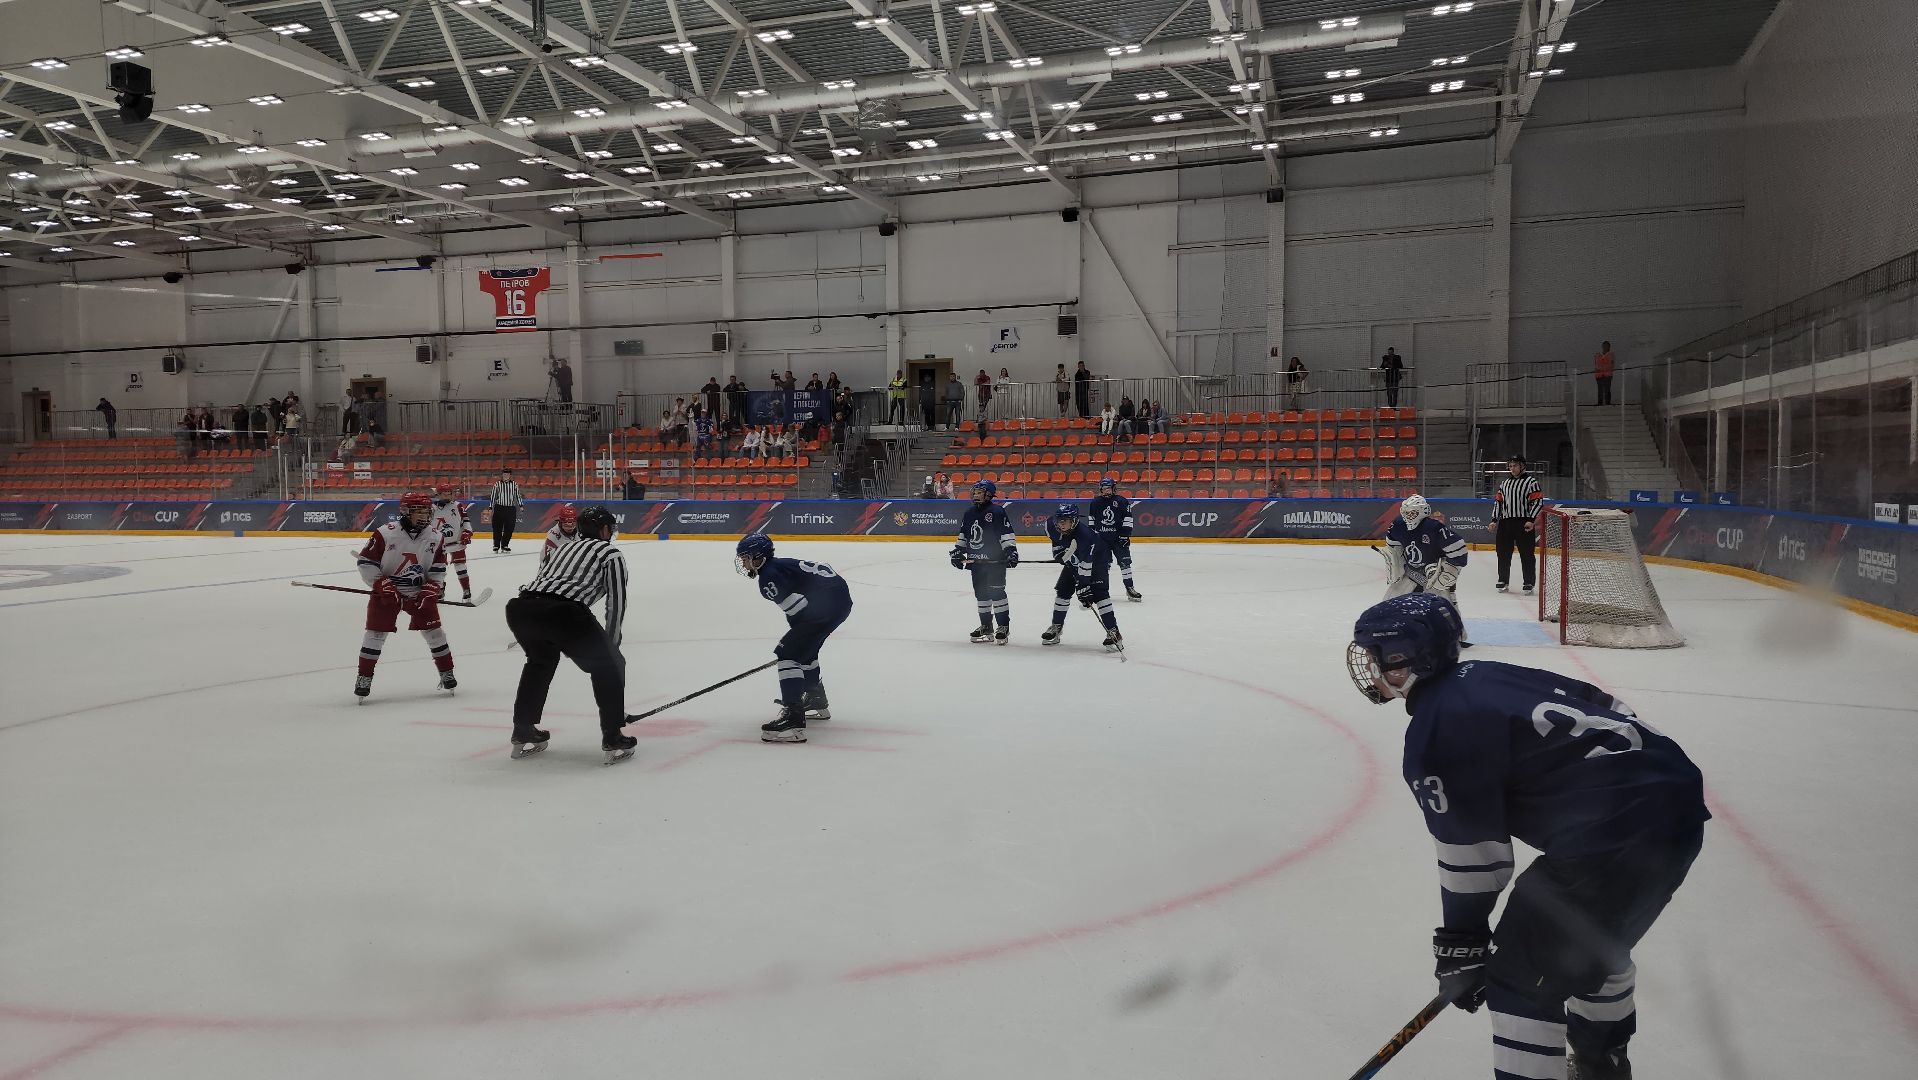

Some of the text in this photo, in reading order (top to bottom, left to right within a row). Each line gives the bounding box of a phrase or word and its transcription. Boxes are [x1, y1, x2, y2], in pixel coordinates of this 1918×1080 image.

[501, 279, 530, 289] ПЕТРОВ
[504, 289, 526, 315] 16
[1000, 328, 1010, 341] F
[494, 359, 503, 371] E
[130, 373, 138, 383] D
[790, 513, 834, 524] Infinix
[1283, 511, 1352, 525] ПАПА ДЖОНС
[1432, 944, 1485, 959] AUER
